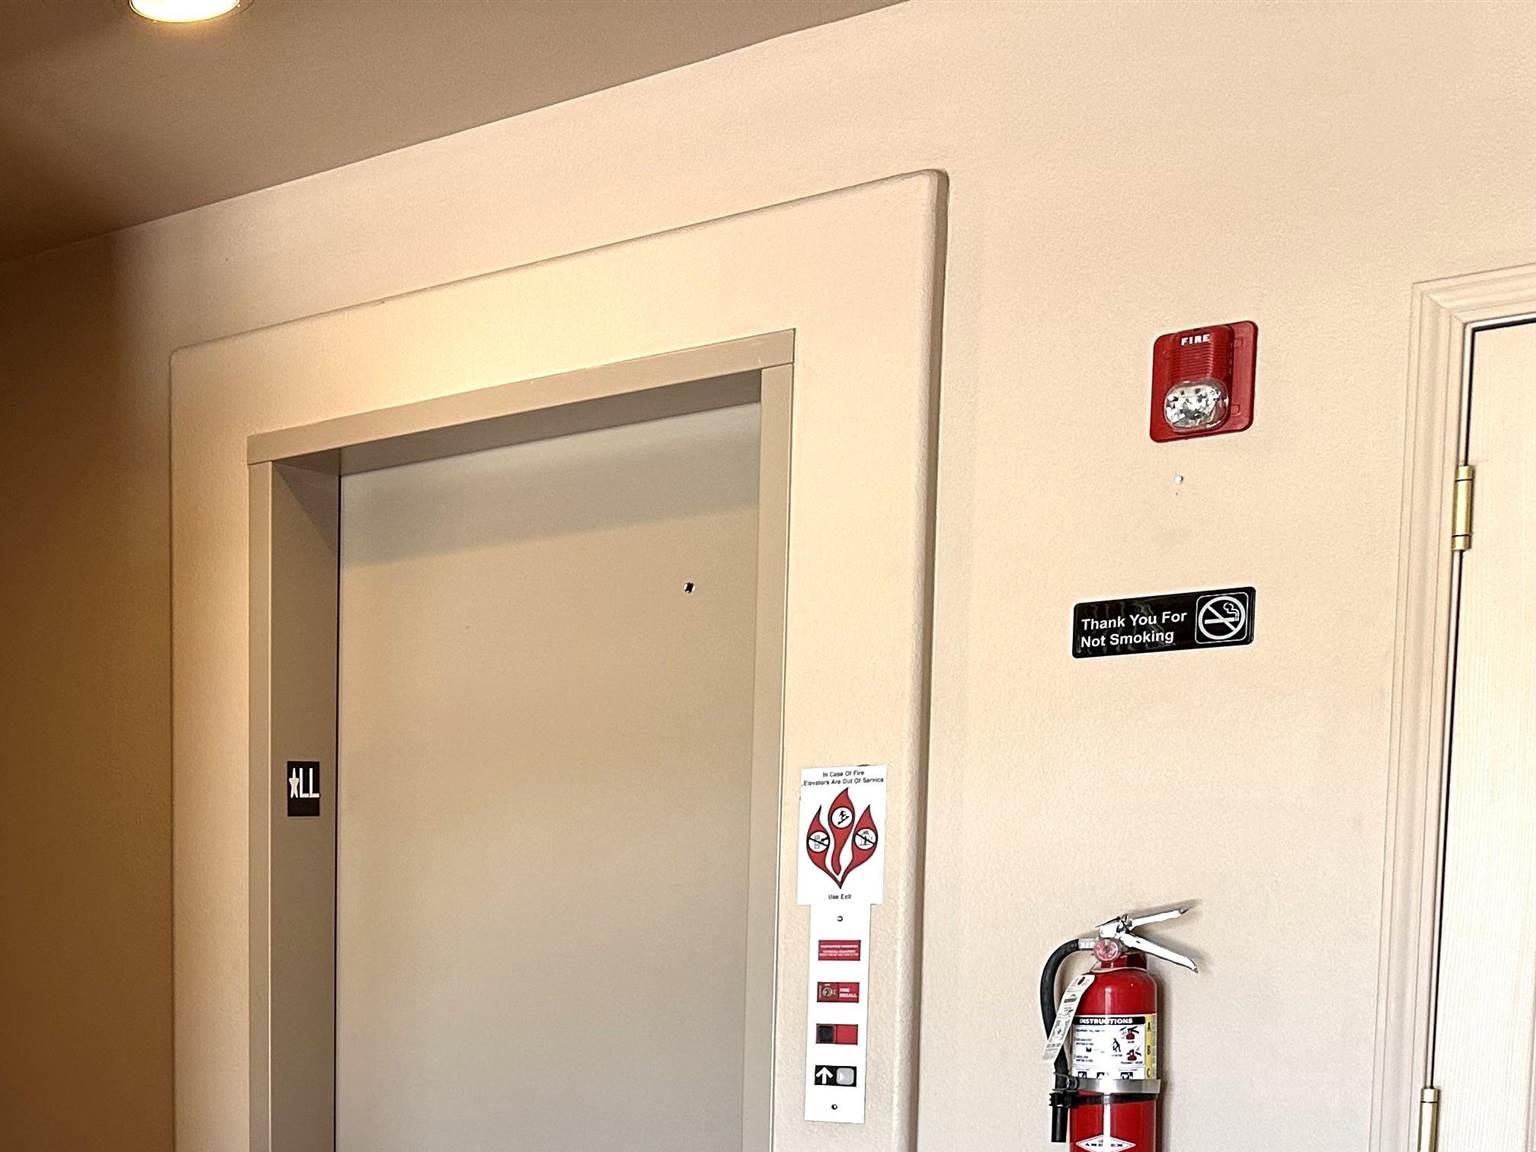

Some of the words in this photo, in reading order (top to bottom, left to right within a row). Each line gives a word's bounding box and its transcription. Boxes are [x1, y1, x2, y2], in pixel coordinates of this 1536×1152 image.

[1181, 334, 1211, 346] FIRE
[1081, 617, 1125, 631] Thank
[1129, 614, 1157, 627] You
[1161, 611, 1188, 624] For
[1081, 635, 1106, 648] Not
[1109, 631, 1174, 646] Smoking
